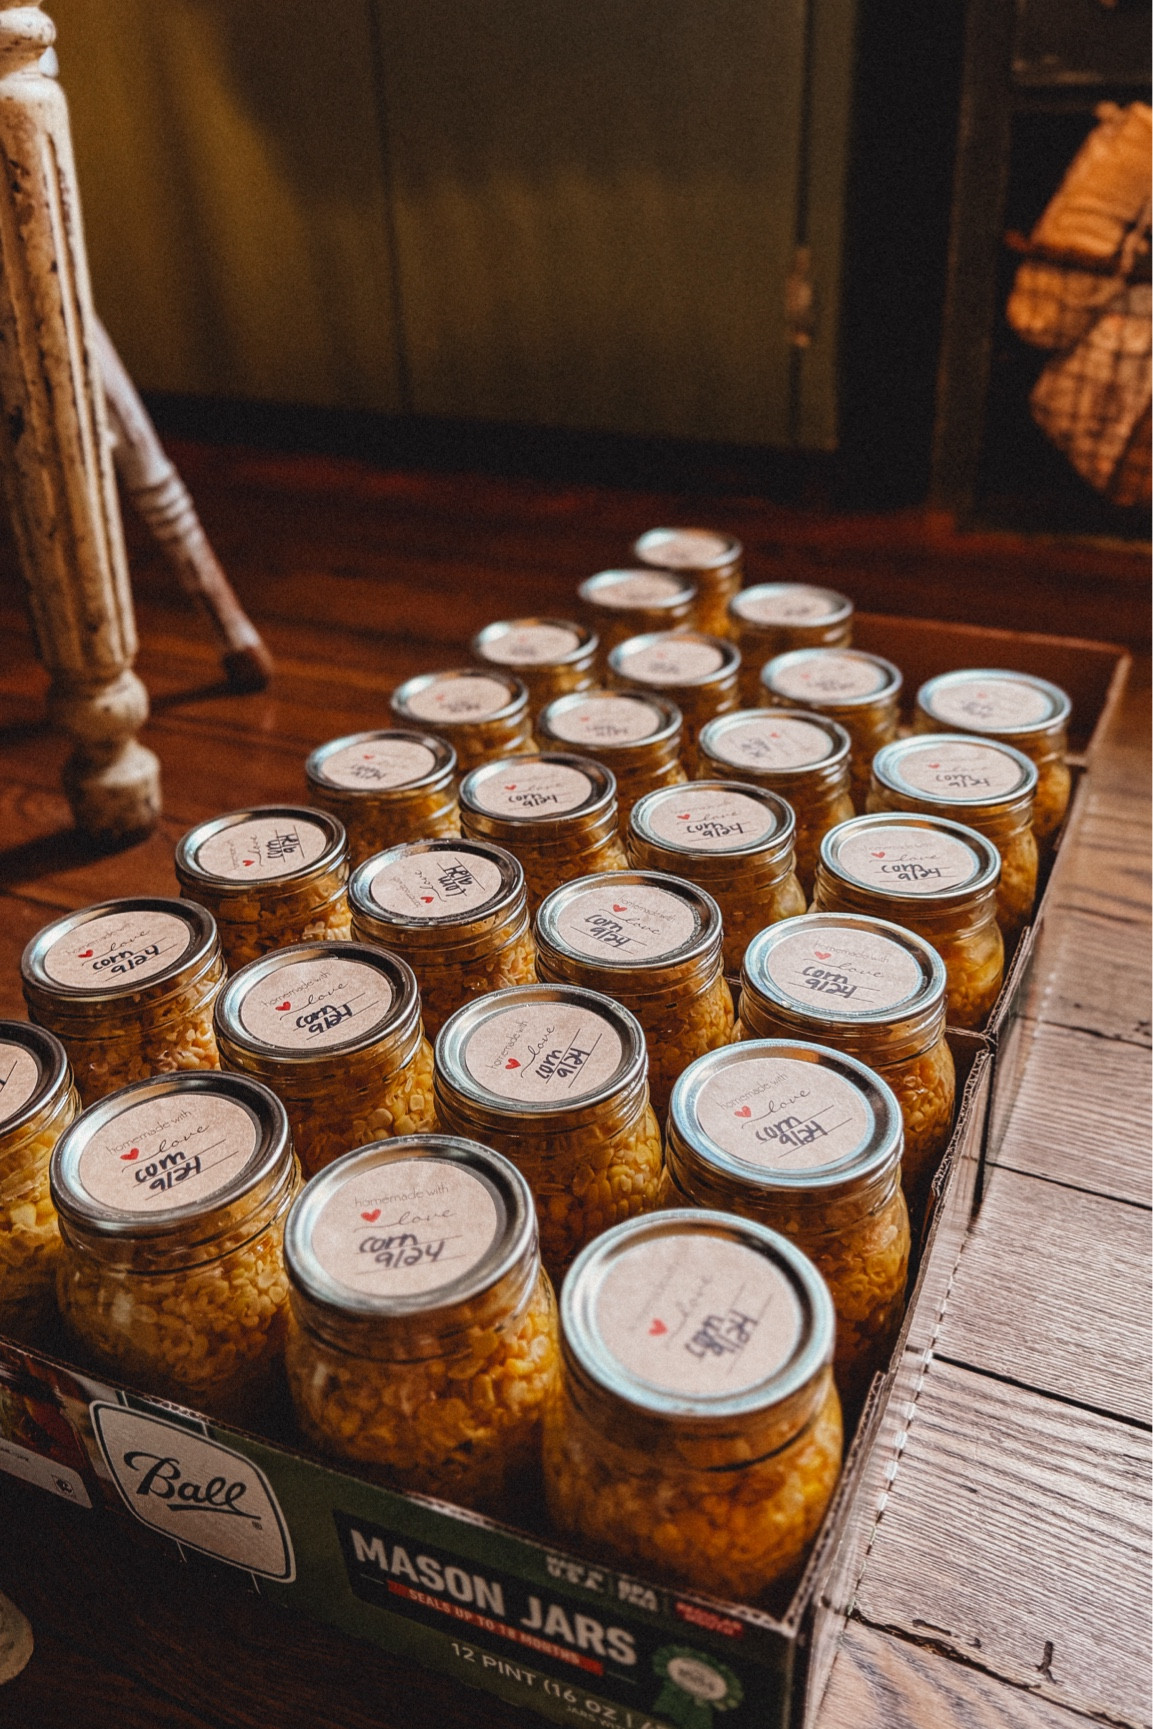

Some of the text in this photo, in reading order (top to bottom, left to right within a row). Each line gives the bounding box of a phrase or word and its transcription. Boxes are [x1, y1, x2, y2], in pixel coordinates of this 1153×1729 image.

[584, 914, 623, 932] corn
[92, 950, 134, 970] corn
[802, 966, 848, 984] corn
[296, 1004, 338, 1028] corn
[535, 1050, 562, 1079] corn
[755, 1115, 802, 1141] corn
[135, 1151, 186, 1183] corn
[354, 1184, 449, 1207] homemade with
[359, 1233, 418, 1253] corn
[123, 1451, 261, 1520] Ball
[351, 1528, 505, 1616] MASON
[521, 1596, 637, 1666] JARS
[408, 1588, 450, 1614] SEALS
[455, 1607, 472, 1621] UP
[477, 1615, 495, 1632] TO
[521, 1629, 581, 1664] MONTHS
[452, 1643, 476, 1663] 12
[482, 1655, 536, 1686] PINT
[544, 1680, 577, 1703] (16
[585, 1700, 616, 1720] OZ
